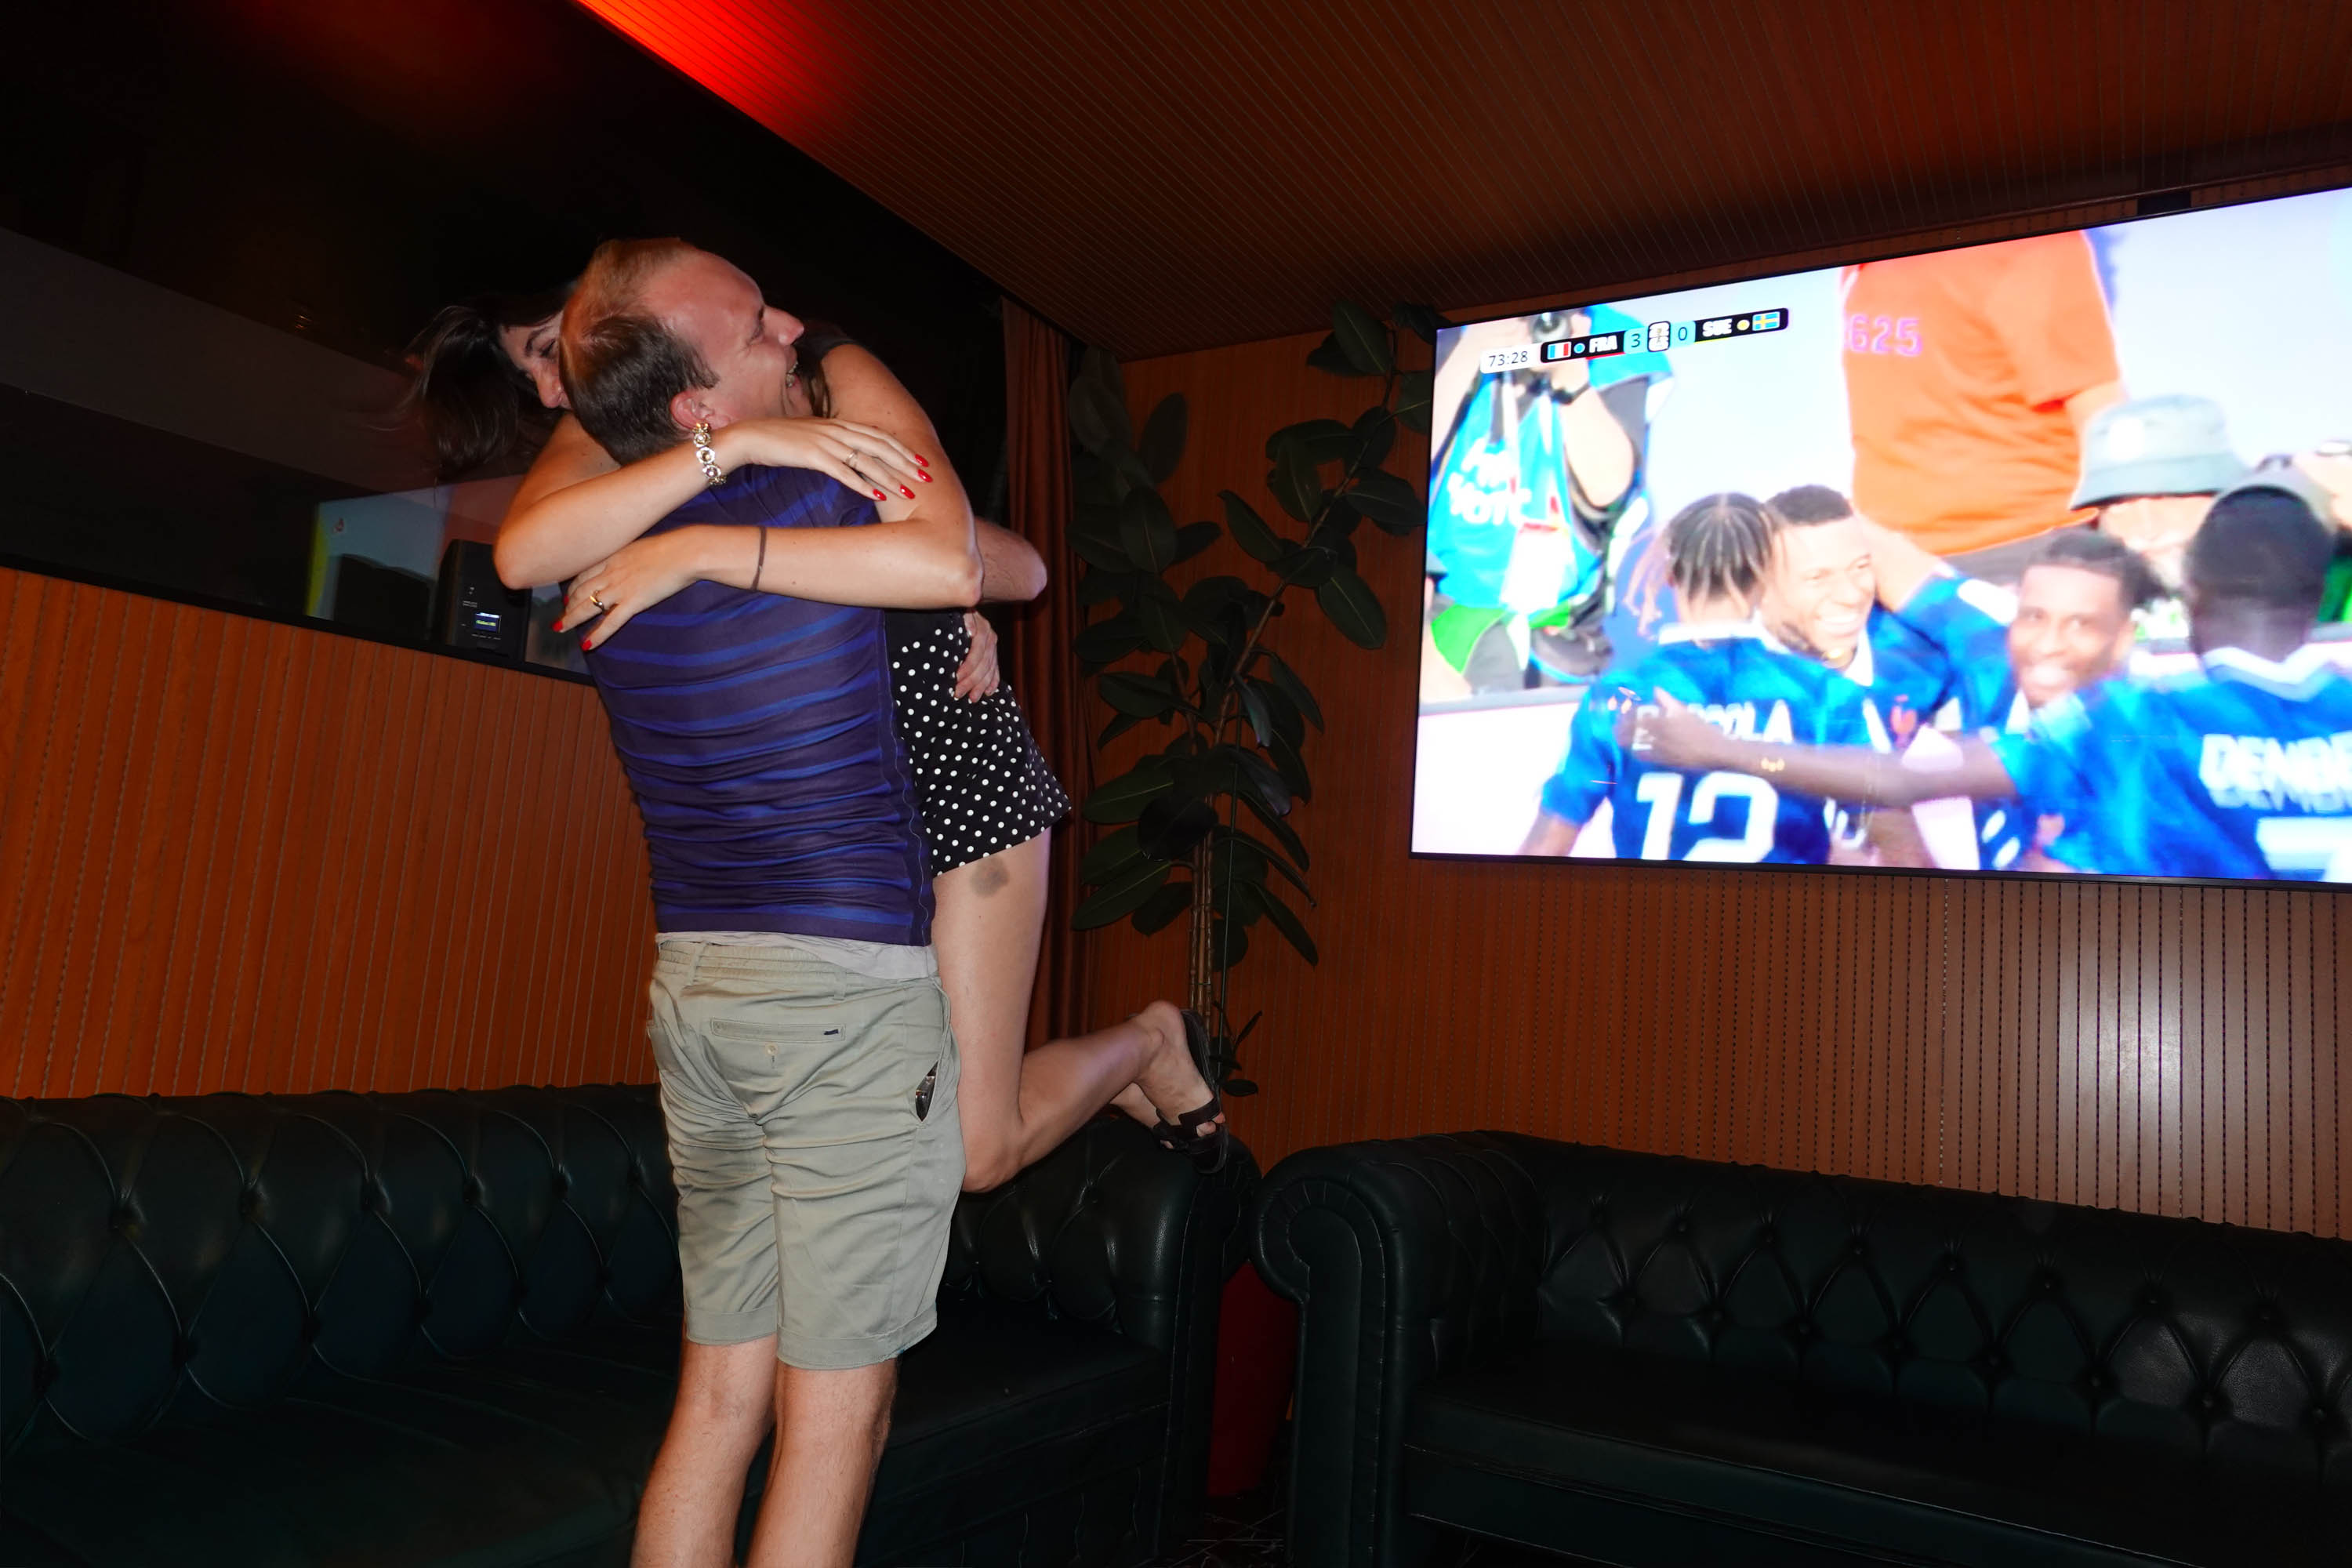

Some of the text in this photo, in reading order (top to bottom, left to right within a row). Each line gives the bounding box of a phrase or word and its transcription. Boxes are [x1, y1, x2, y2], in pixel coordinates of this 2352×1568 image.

[1488, 350, 1528, 368] 73:28
[1588, 335, 1618, 353] FRA
[1630, 333, 1641, 348] 3
[1678, 326, 1688, 341] 0
[1636, 771, 1780, 863] 12
